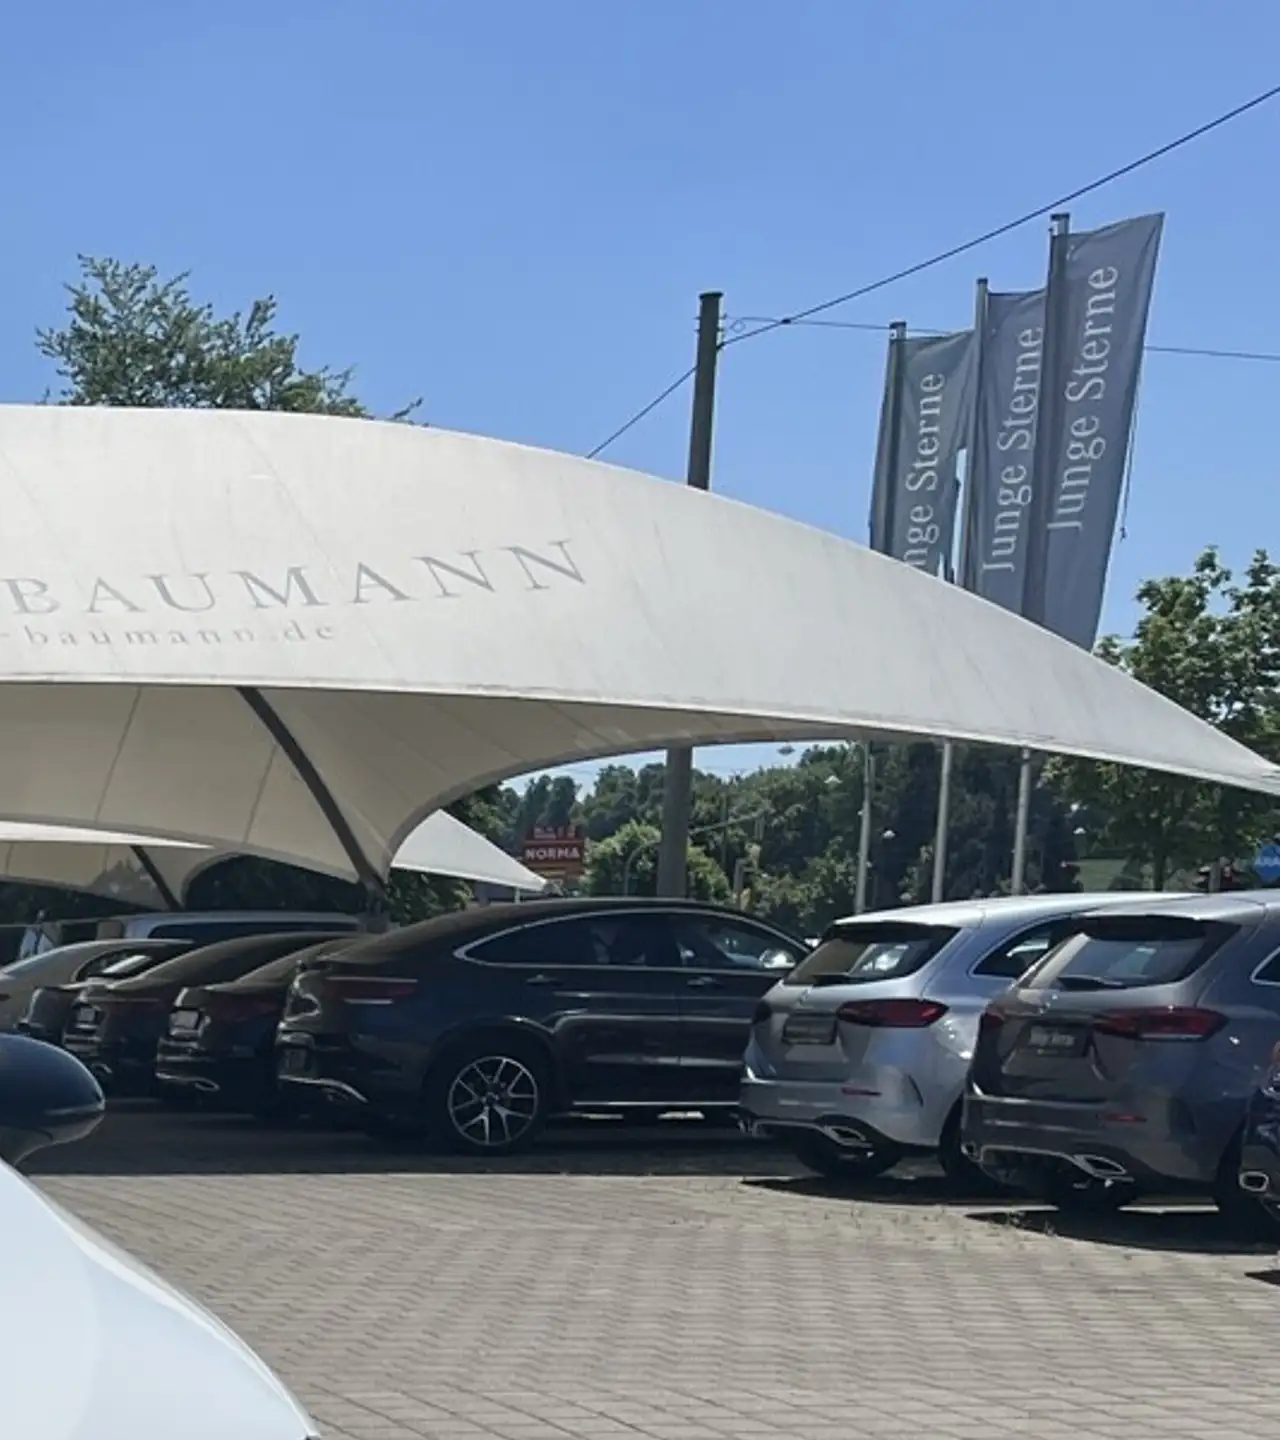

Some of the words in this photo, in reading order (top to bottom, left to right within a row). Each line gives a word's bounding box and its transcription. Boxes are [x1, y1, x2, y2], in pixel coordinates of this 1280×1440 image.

[996, 326, 1043, 451] Sterne
[1064, 265, 1118, 402] Sterne
[905, 373, 946, 491] Sterne
[1047, 415, 1106, 532] Junge
[902, 504, 940, 567] nge
[982, 463, 1032, 573] Junge
[3, 539, 588, 616] BAUMANN
